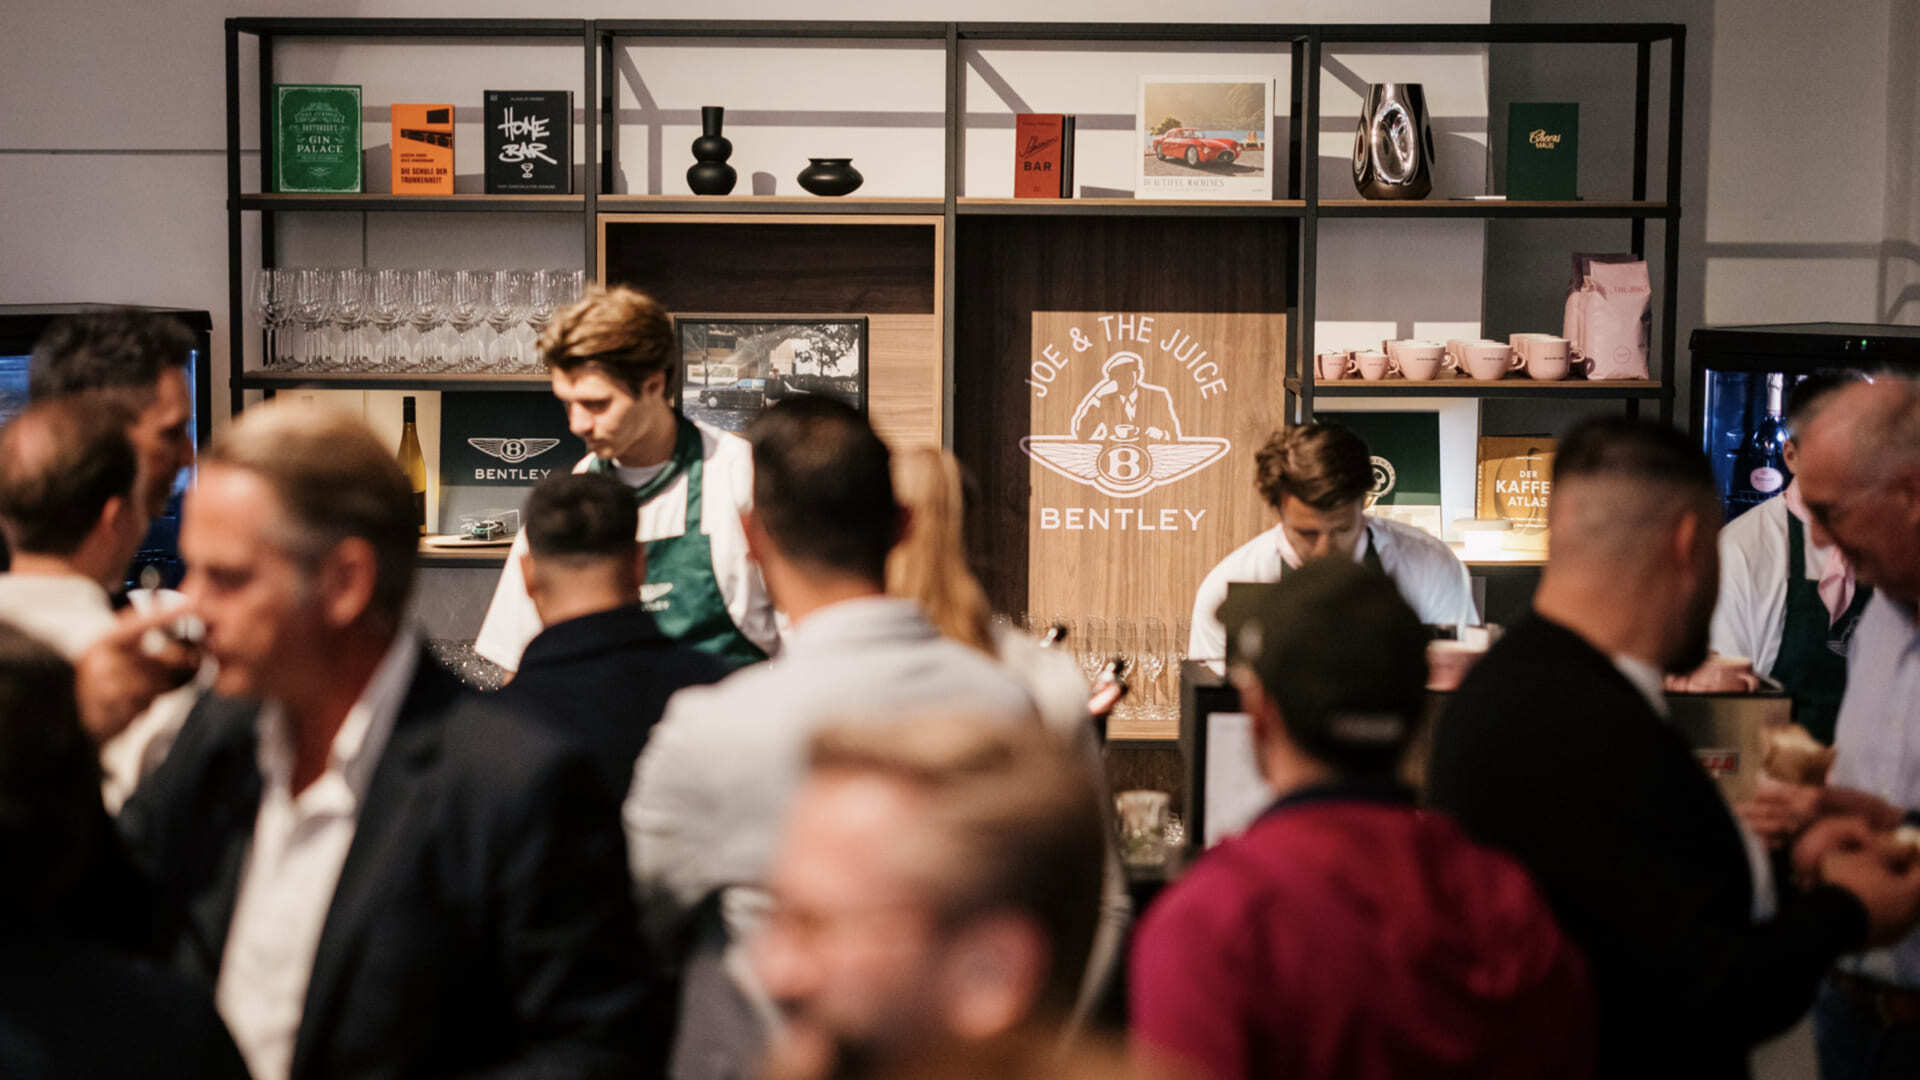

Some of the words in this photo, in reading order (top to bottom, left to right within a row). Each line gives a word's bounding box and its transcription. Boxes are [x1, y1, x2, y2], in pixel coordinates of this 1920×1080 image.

[497, 106, 550, 141] HOME
[309, 135, 330, 144] GIN
[297, 144, 343, 153] PALACE
[499, 142, 558, 165] BAR
[1023, 161, 1052, 172] BAR
[1024, 344, 1069, 398] JOE
[1069, 327, 1093, 352] &
[1097, 314, 1155, 343] THE
[1159, 328, 1229, 400] JUICE
[1107, 447, 1141, 480] B
[474, 468, 551, 480] BENTLEY
[1519, 470, 1538, 479] DER
[1495, 479, 1551, 495] KAFFE
[1507, 495, 1548, 508] ATLAS
[1040, 507, 1207, 531] BENTLEY
